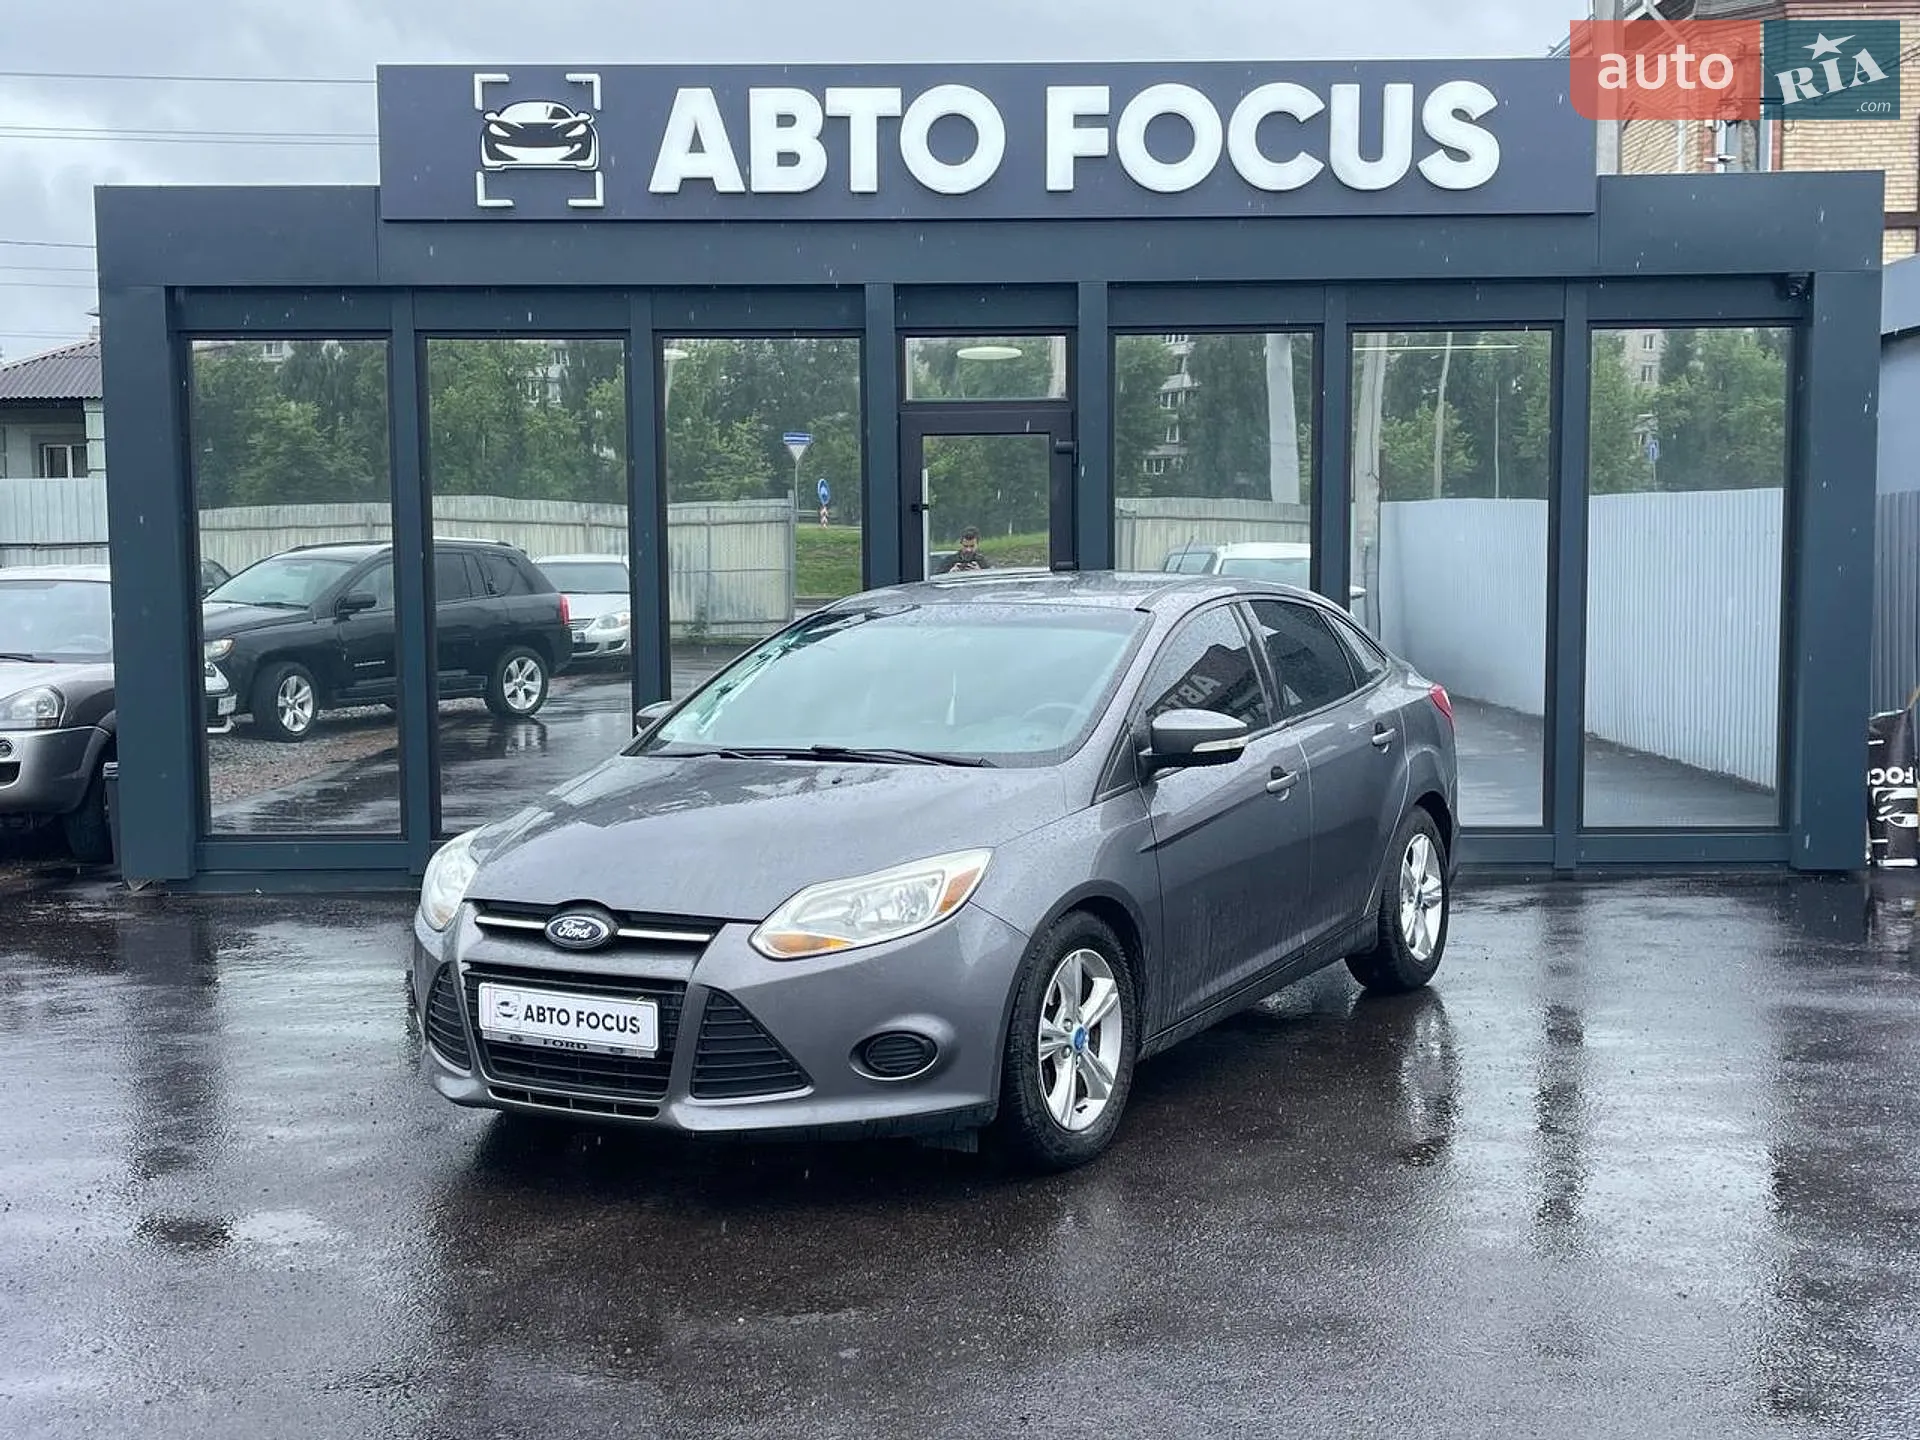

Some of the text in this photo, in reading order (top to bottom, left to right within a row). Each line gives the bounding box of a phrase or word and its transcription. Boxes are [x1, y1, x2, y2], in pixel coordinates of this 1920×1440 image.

[648, 80, 1500, 195] АВТО FOCUS
[1867, 766, 1914, 786] FOC
[556, 919, 593, 941] Ford
[523, 1003, 641, 1035] АВТО FOCUS
